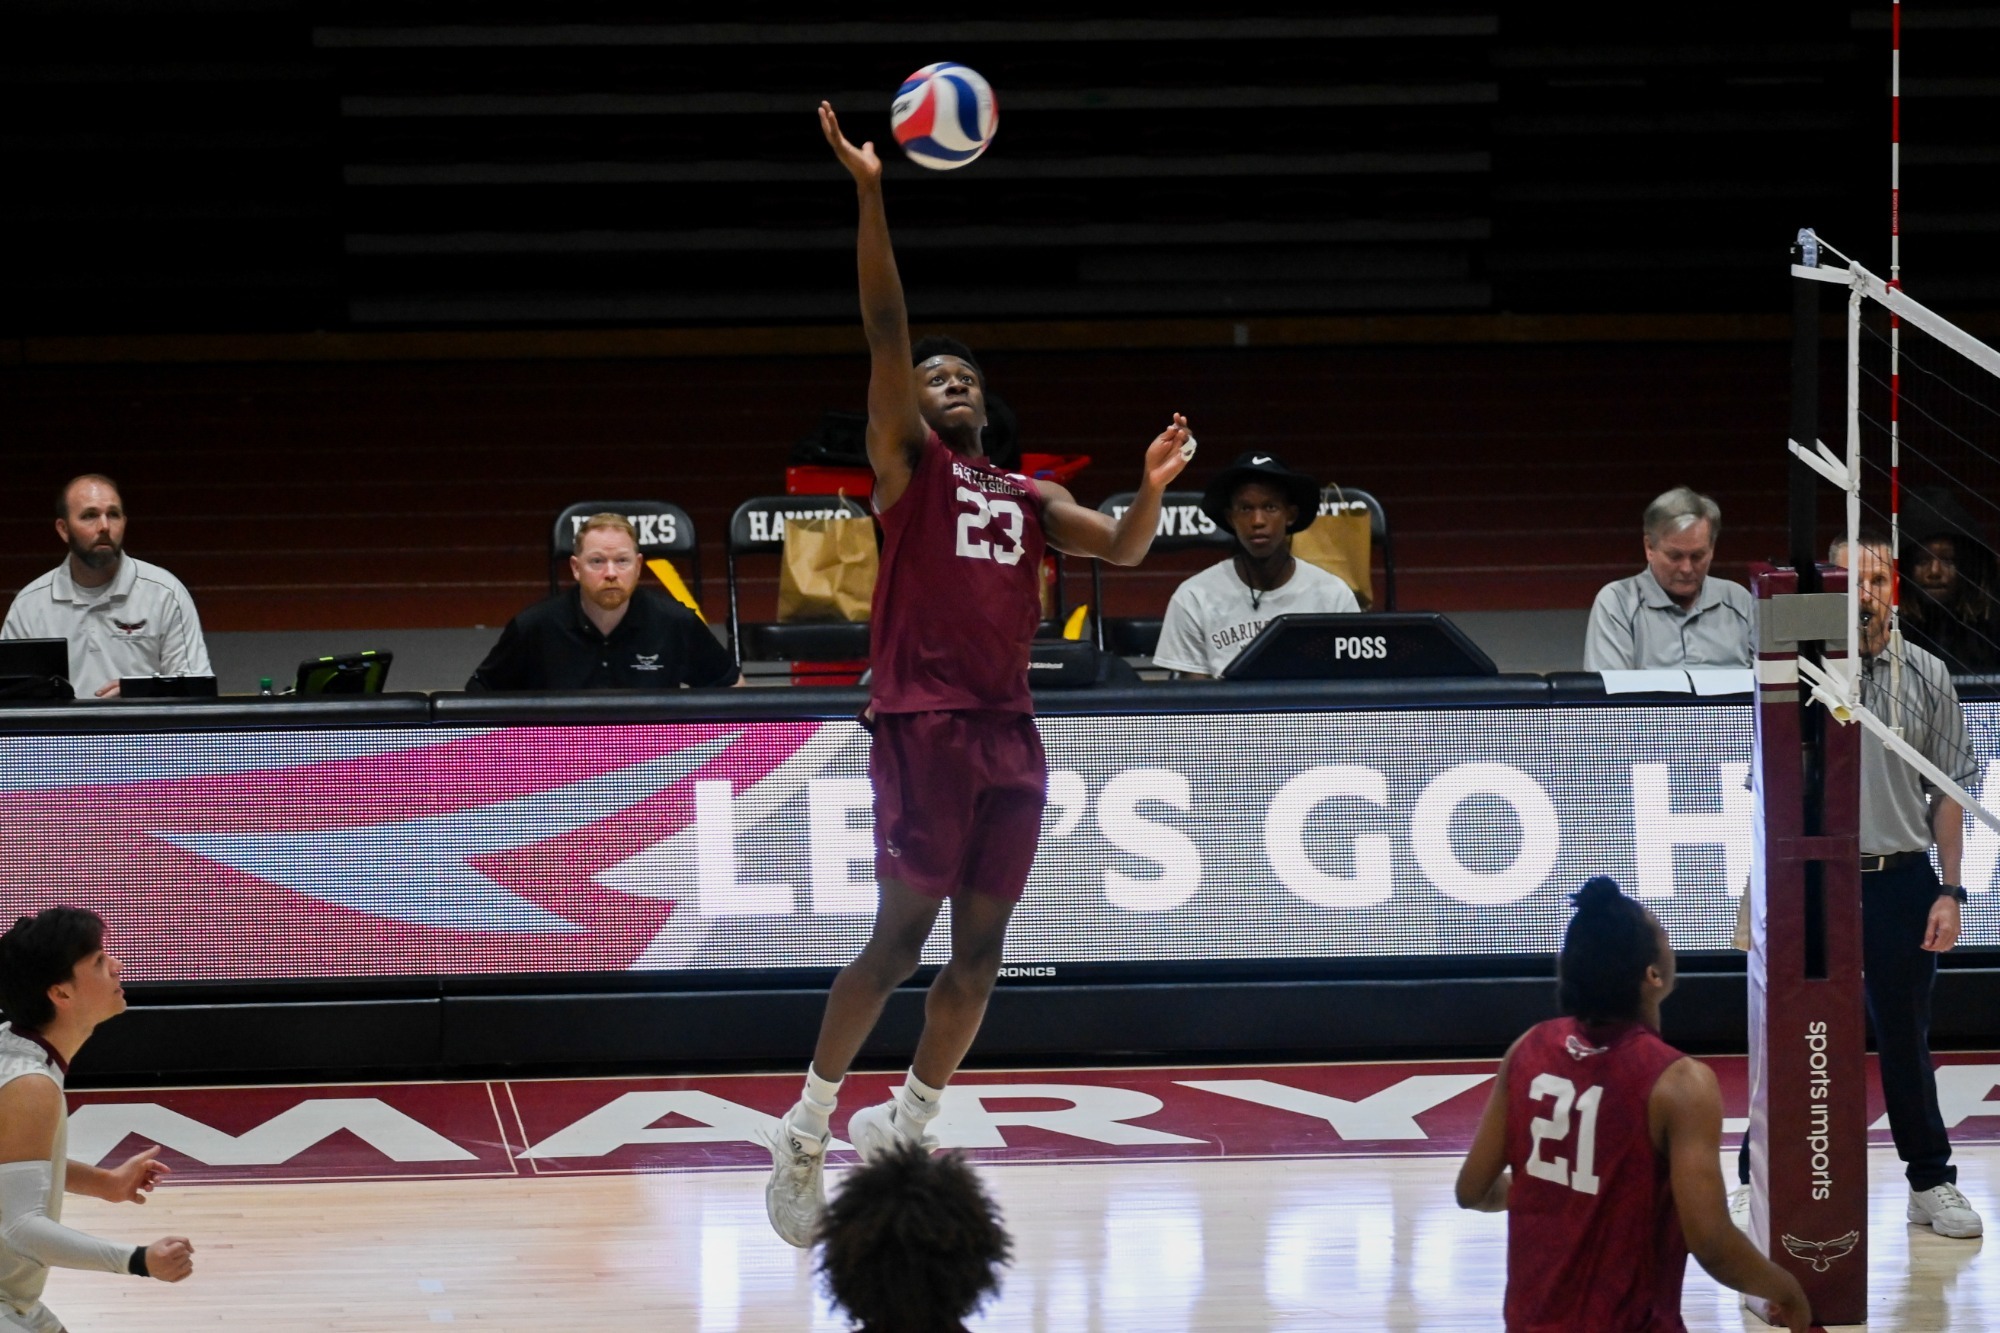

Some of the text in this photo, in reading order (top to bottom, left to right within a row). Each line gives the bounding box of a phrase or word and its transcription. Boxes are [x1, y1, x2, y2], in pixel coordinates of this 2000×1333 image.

[956, 486, 1026, 566] 23
[1112, 505, 1217, 536] WKS
[1335, 636, 1387, 659] POSS
[694, 768, 1202, 916] LE'S
[1264, 762, 1562, 907] GO
[997, 967, 1056, 977] RONICS
[1525, 1072, 1604, 1196] 21
[1805, 1021, 1832, 1200] sports imports
